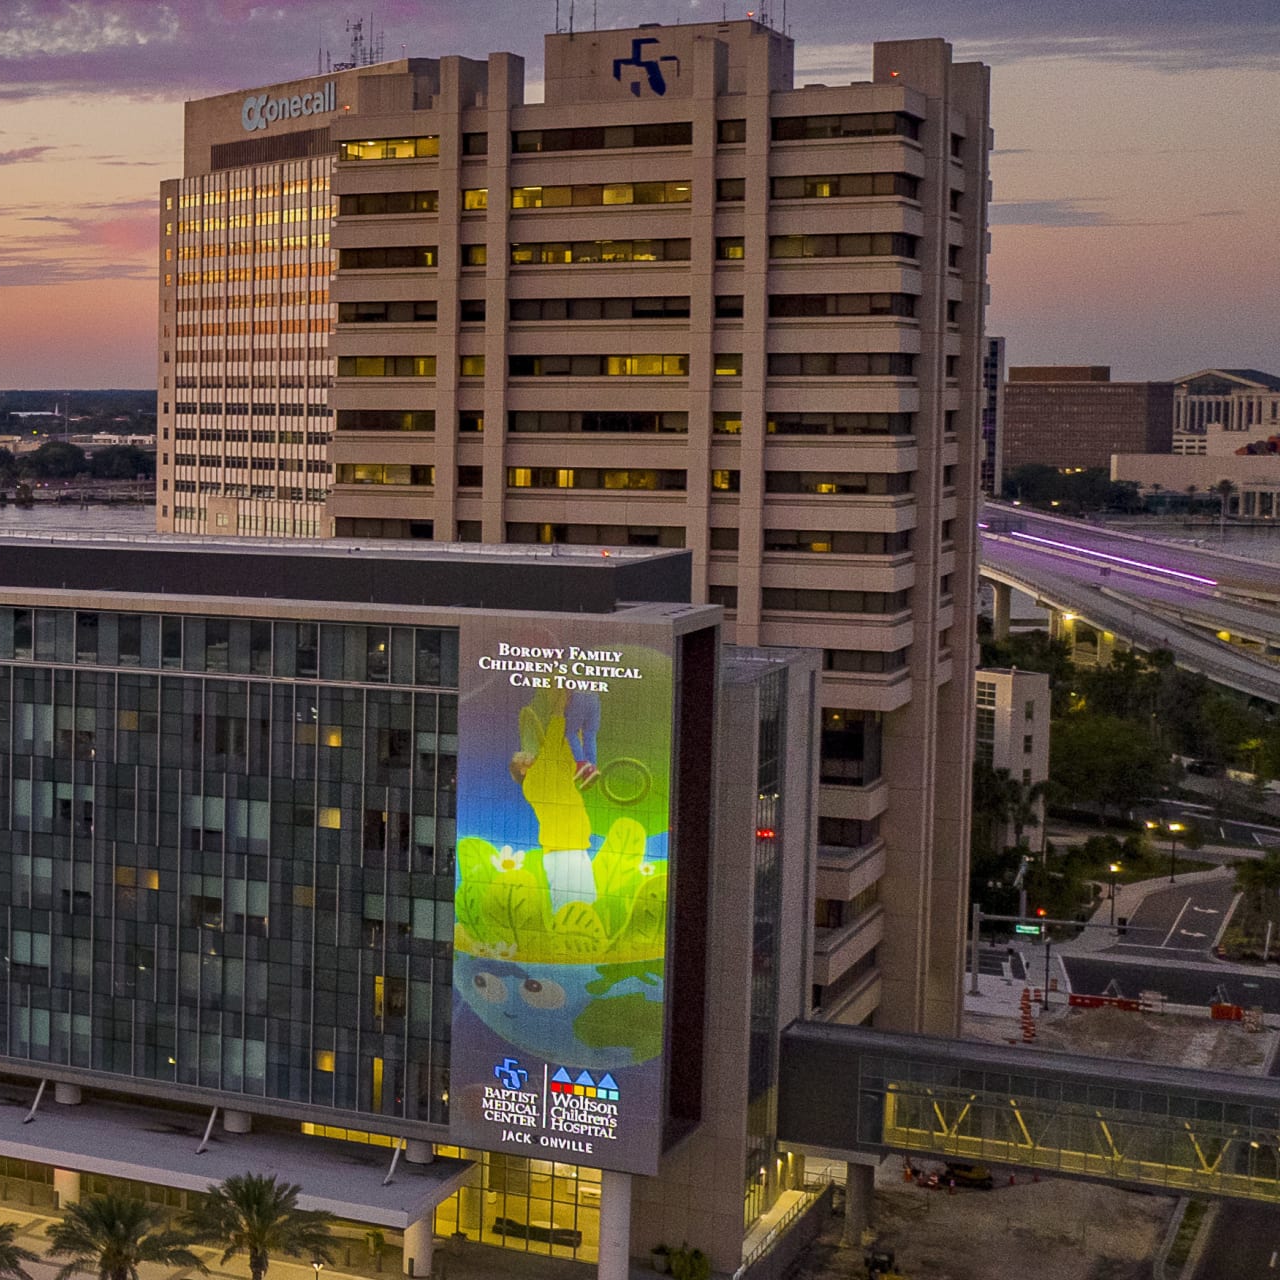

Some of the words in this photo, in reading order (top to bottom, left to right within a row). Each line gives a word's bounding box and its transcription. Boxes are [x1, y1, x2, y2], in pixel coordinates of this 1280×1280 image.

[266, 81, 336, 121] onecall
[498, 643, 565, 660] BOROWY
[569, 646, 624, 663] FAMILY
[572, 662, 642, 679] CRITICAL
[509, 673, 551, 689] CARE
[554, 675, 609, 692] TOWER
[484, 1086, 538, 1104] BAPTIST
[551, 1091, 618, 1116] Wolfson
[482, 1098, 540, 1116] MEDICAL
[484, 1110, 537, 1127] CENTER
[550, 1106, 618, 1128] Children's
[550, 1117, 617, 1140] HOSPITAL
